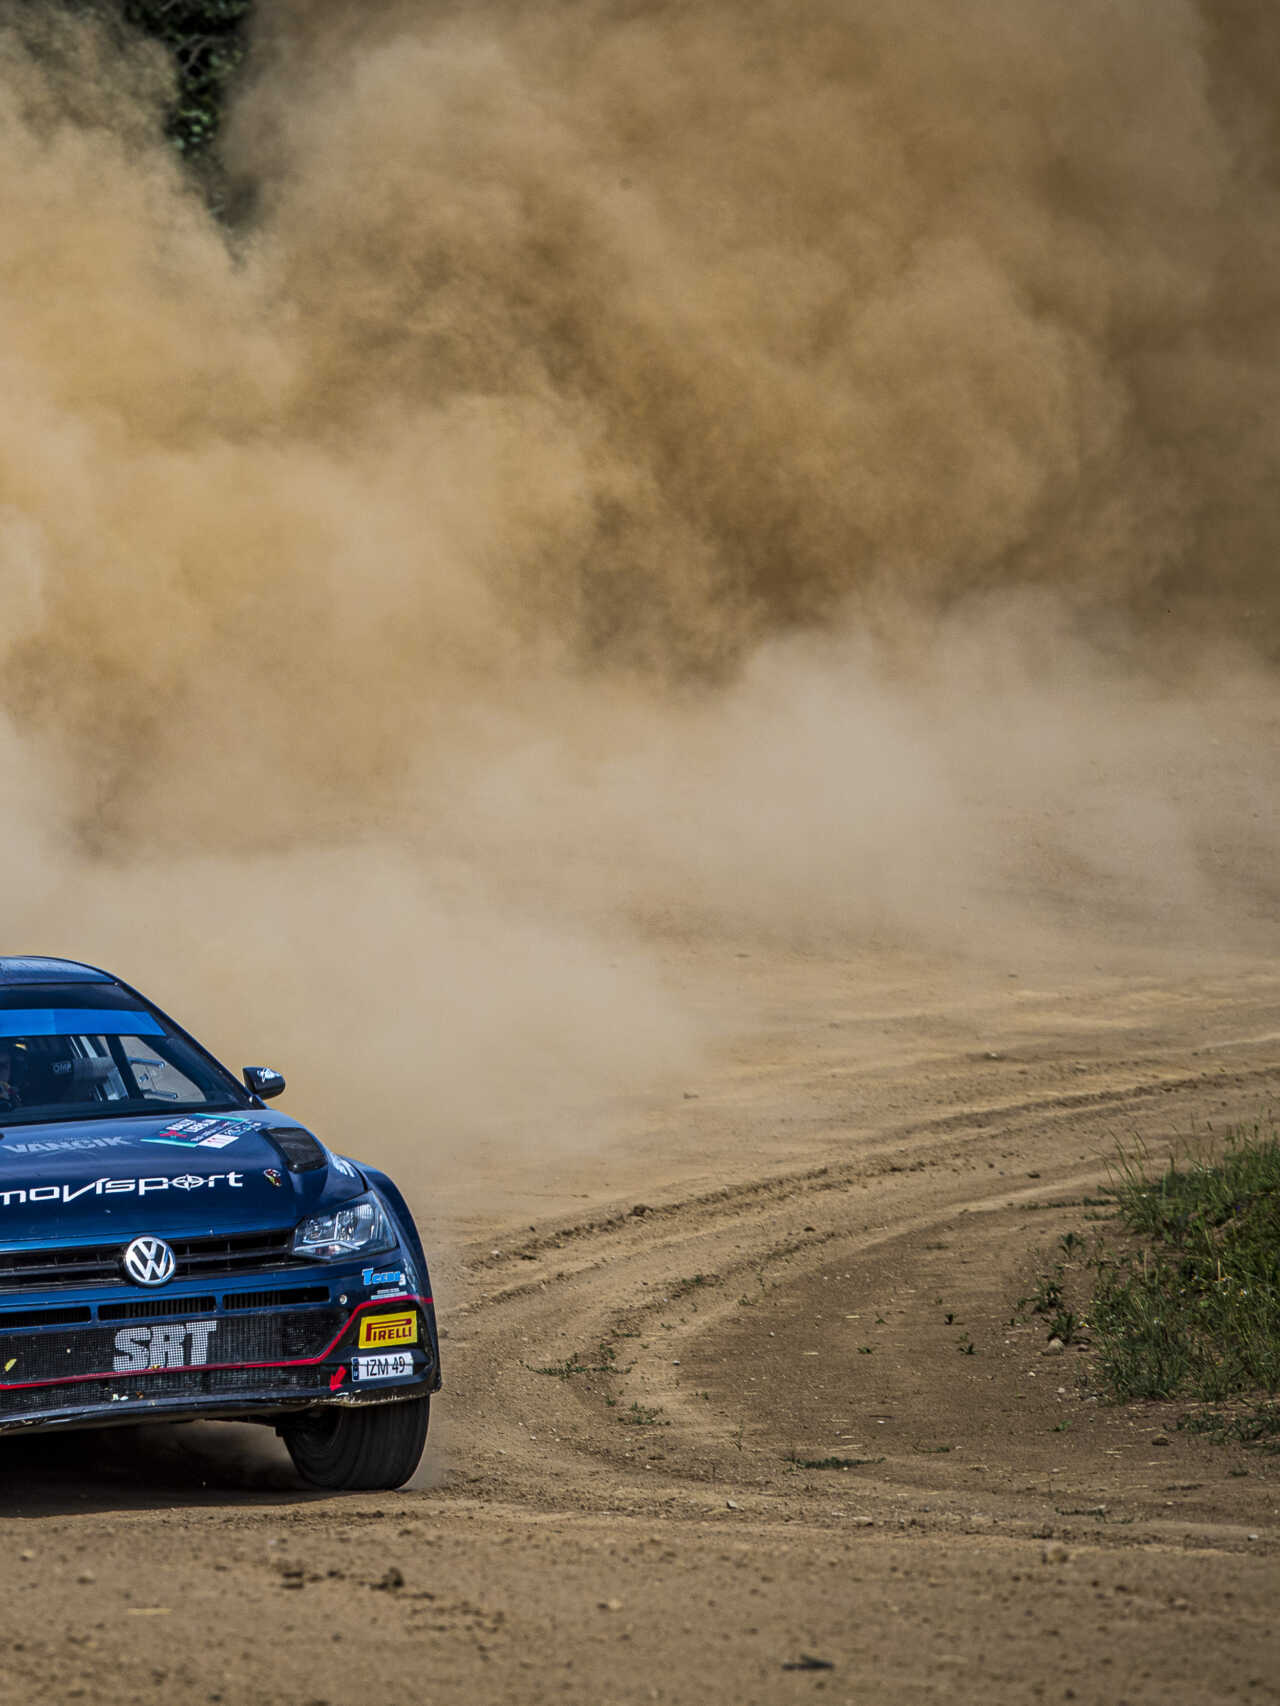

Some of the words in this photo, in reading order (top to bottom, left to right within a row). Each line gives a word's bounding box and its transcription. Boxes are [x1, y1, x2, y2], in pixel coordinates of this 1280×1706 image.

[2, 1135, 133, 1153] VANCIK
[365, 1318, 413, 1342] PIRELLI
[112, 1320, 217, 1373] SRT
[366, 1358, 389, 1377] IZM
[391, 1355, 407, 1374] 49
